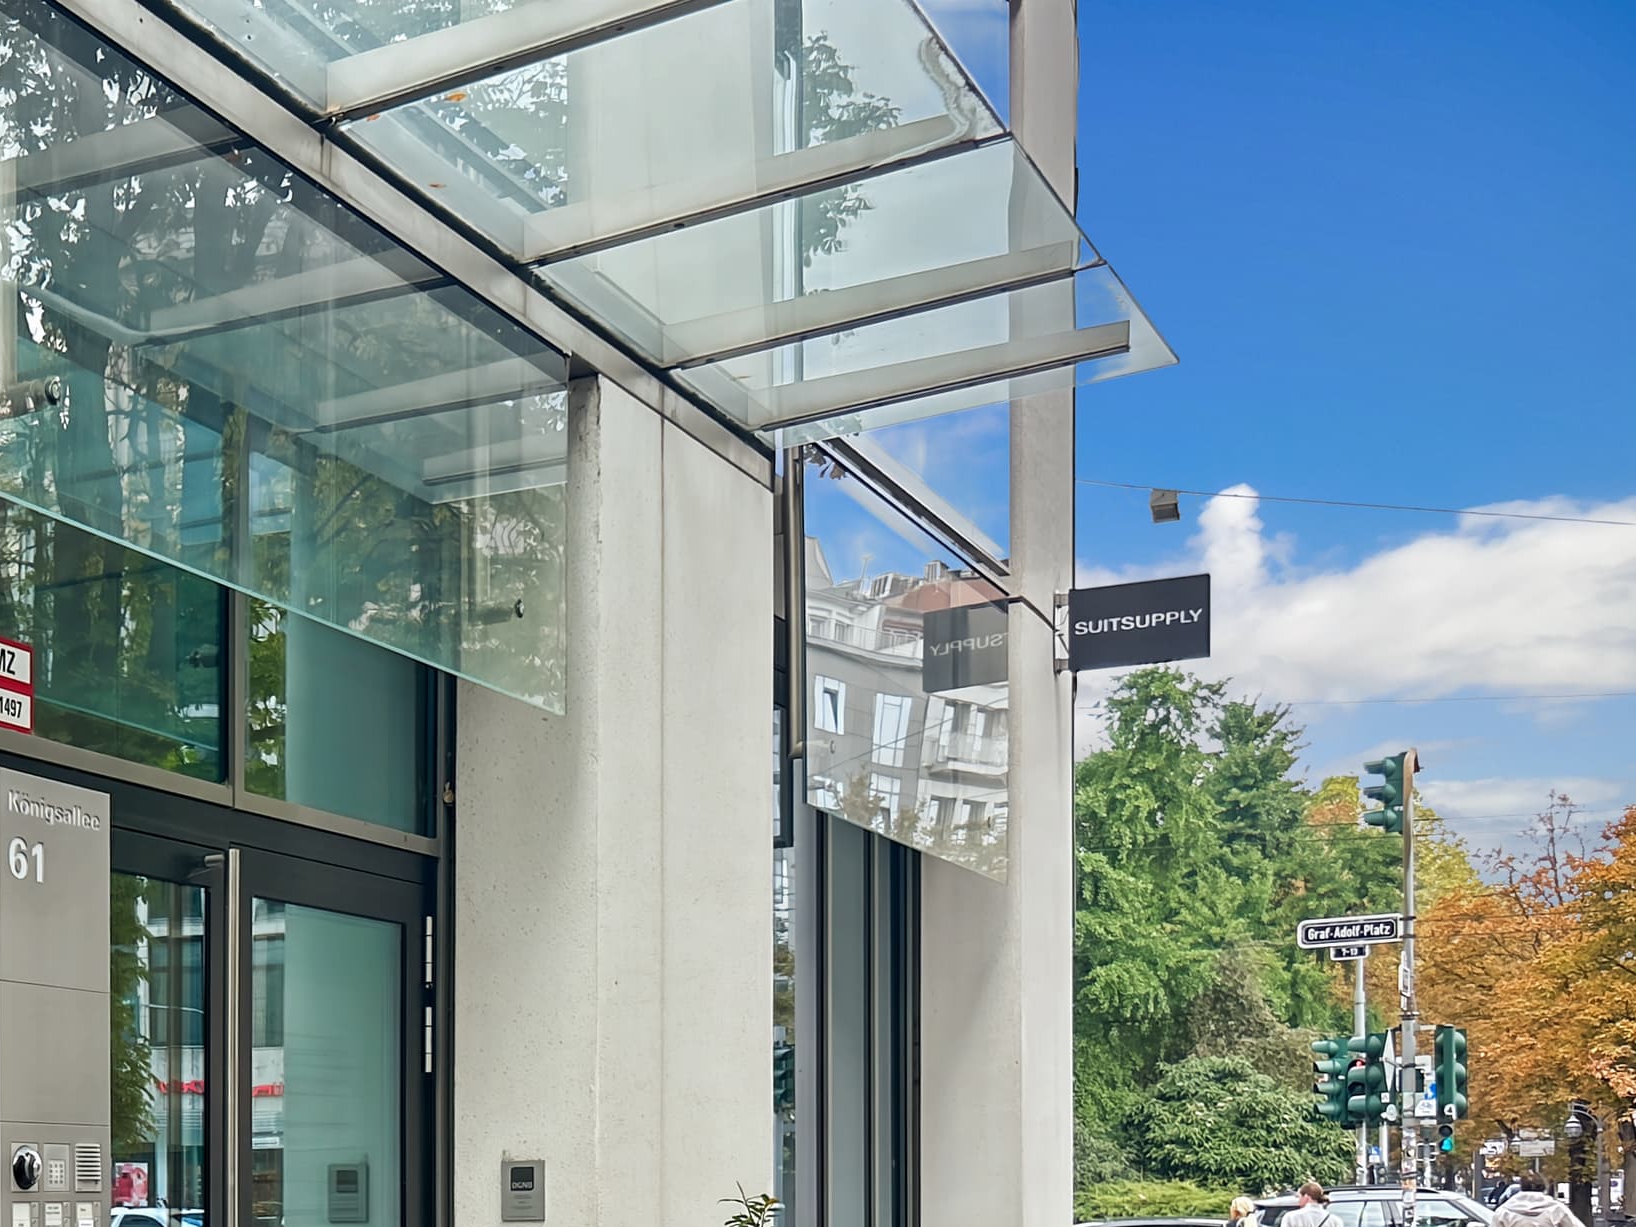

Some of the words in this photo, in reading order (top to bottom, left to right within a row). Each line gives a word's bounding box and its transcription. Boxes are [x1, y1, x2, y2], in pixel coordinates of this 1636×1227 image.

[1075, 608, 1203, 635] SUITSUPPLY
[0, 697, 22, 719] 1497
[8, 790, 100, 831] Königsallee
[8, 837, 45, 883] 61
[1308, 924, 1391, 940] Graf-Adolf-Platz
